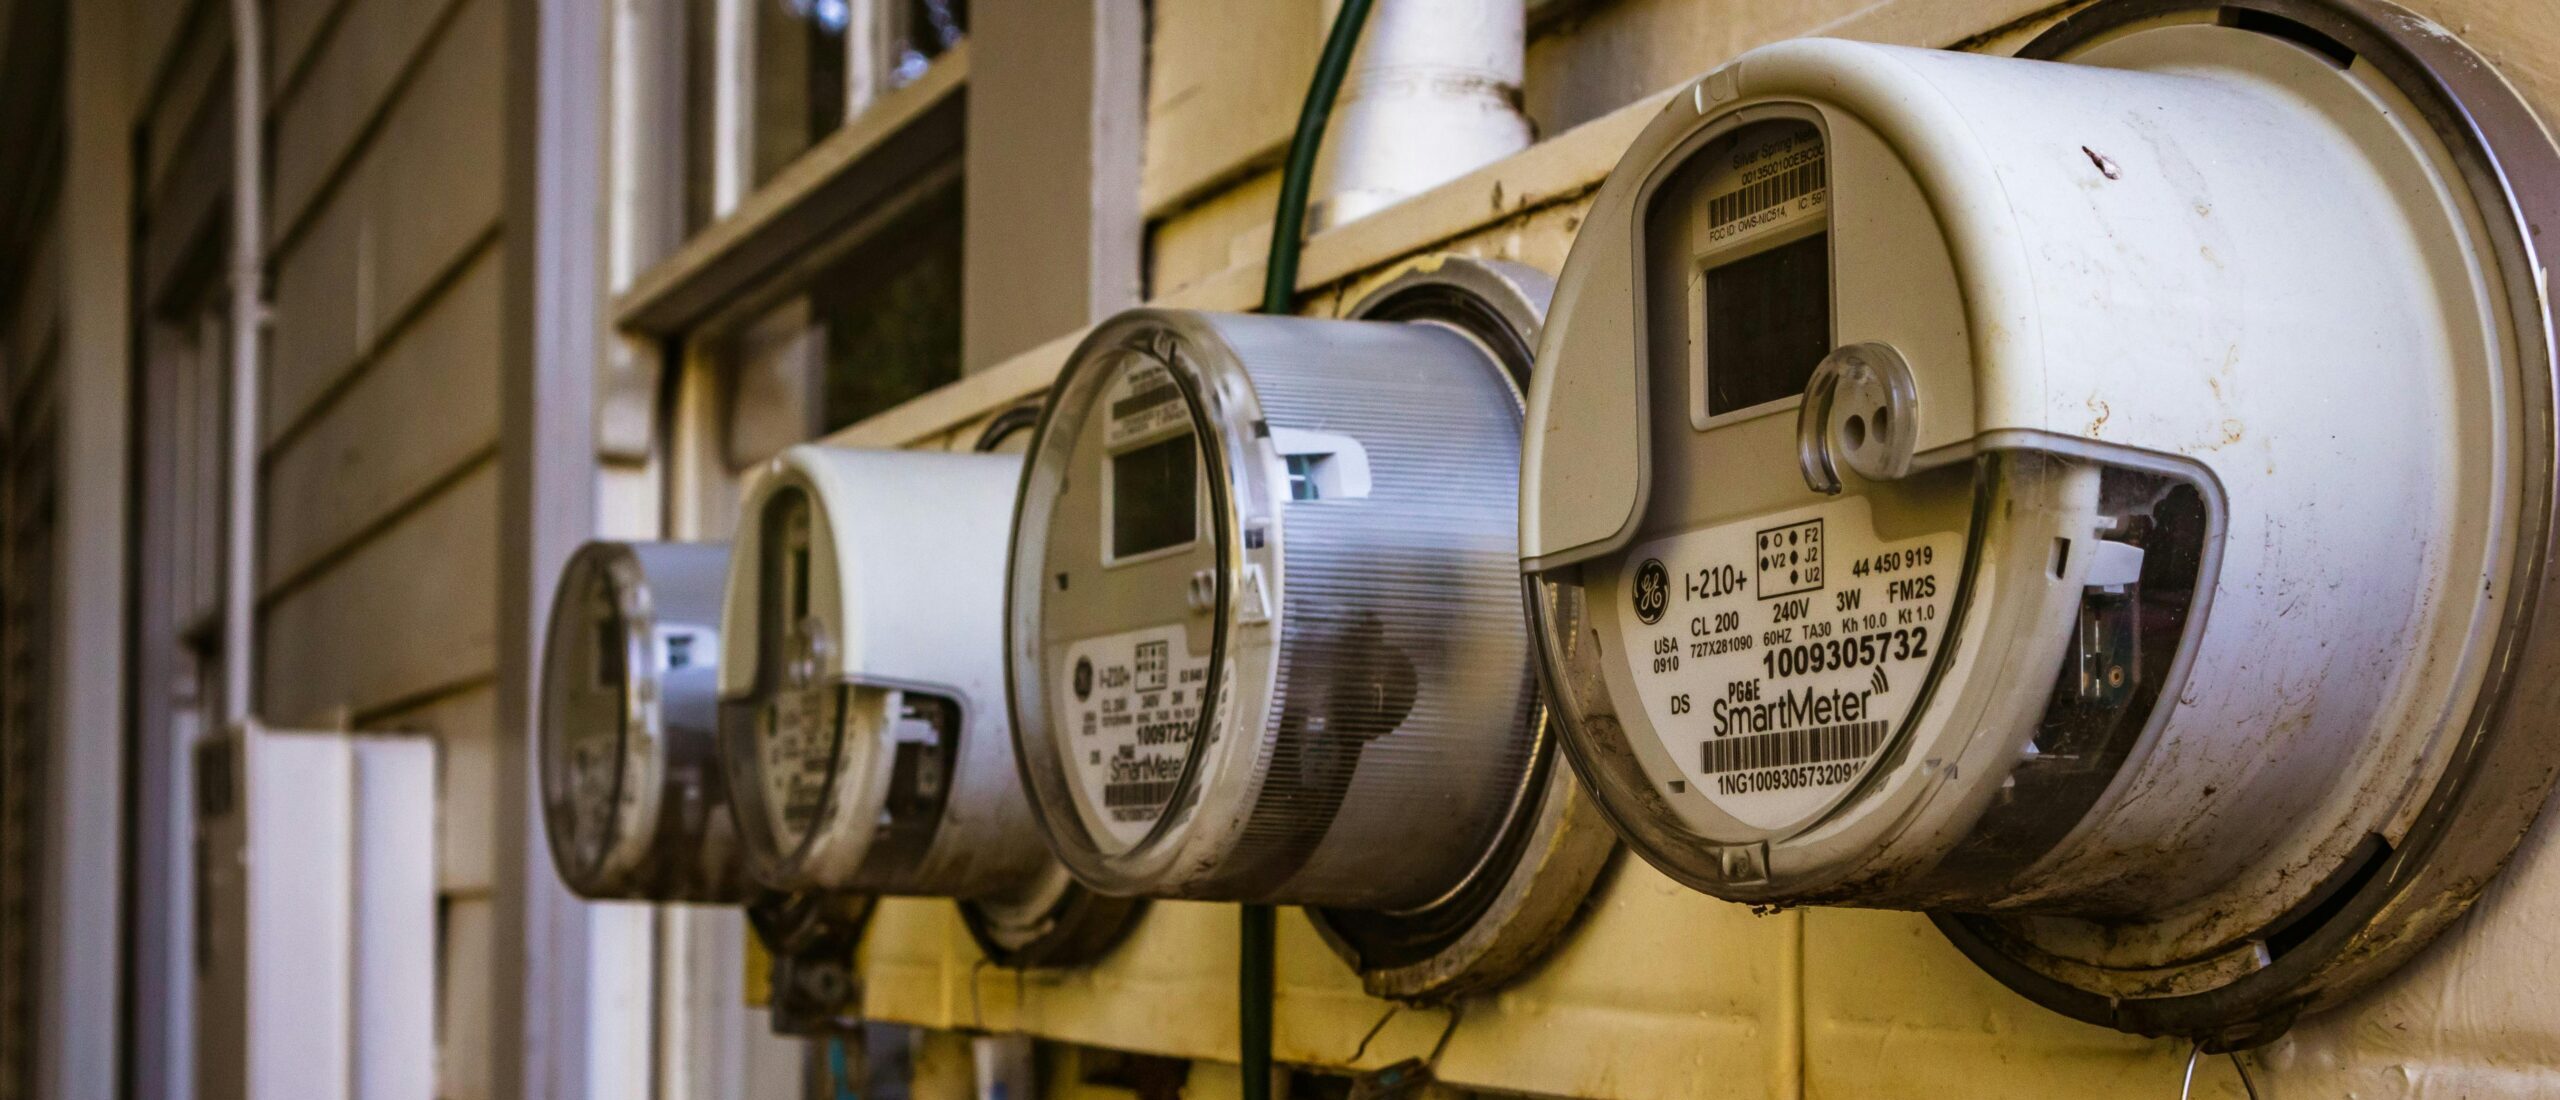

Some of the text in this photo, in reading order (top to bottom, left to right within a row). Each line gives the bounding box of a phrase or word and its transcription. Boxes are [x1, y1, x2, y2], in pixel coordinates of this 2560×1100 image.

[1733, 150, 1760, 170] Silver
[1762, 137, 1792, 160] Spring
[1710, 227, 1725, 242] FCC
[1804, 527, 1818, 544] F2
[1771, 547, 1818, 569] V2 J2
[1853, 546, 1933, 578] 44 450 919
[1685, 564, 1748, 601] I-210+
[1805, 566, 1820, 583] U2
[1691, 575, 1936, 637] CL 200 240V 3W FM2S
[1690, 604, 1935, 658] 727X281090 60HZ TA30 Kh 10.0 Kt 1.0
[1654, 637, 1679, 655] USA
[1763, 626, 1928, 679] 1009305732
[1653, 656, 1679, 674] 0910
[1728, 678, 1760, 703] PG&E
[1671, 693, 1690, 715] DS
[1713, 686, 1871, 737] SmartMeter
